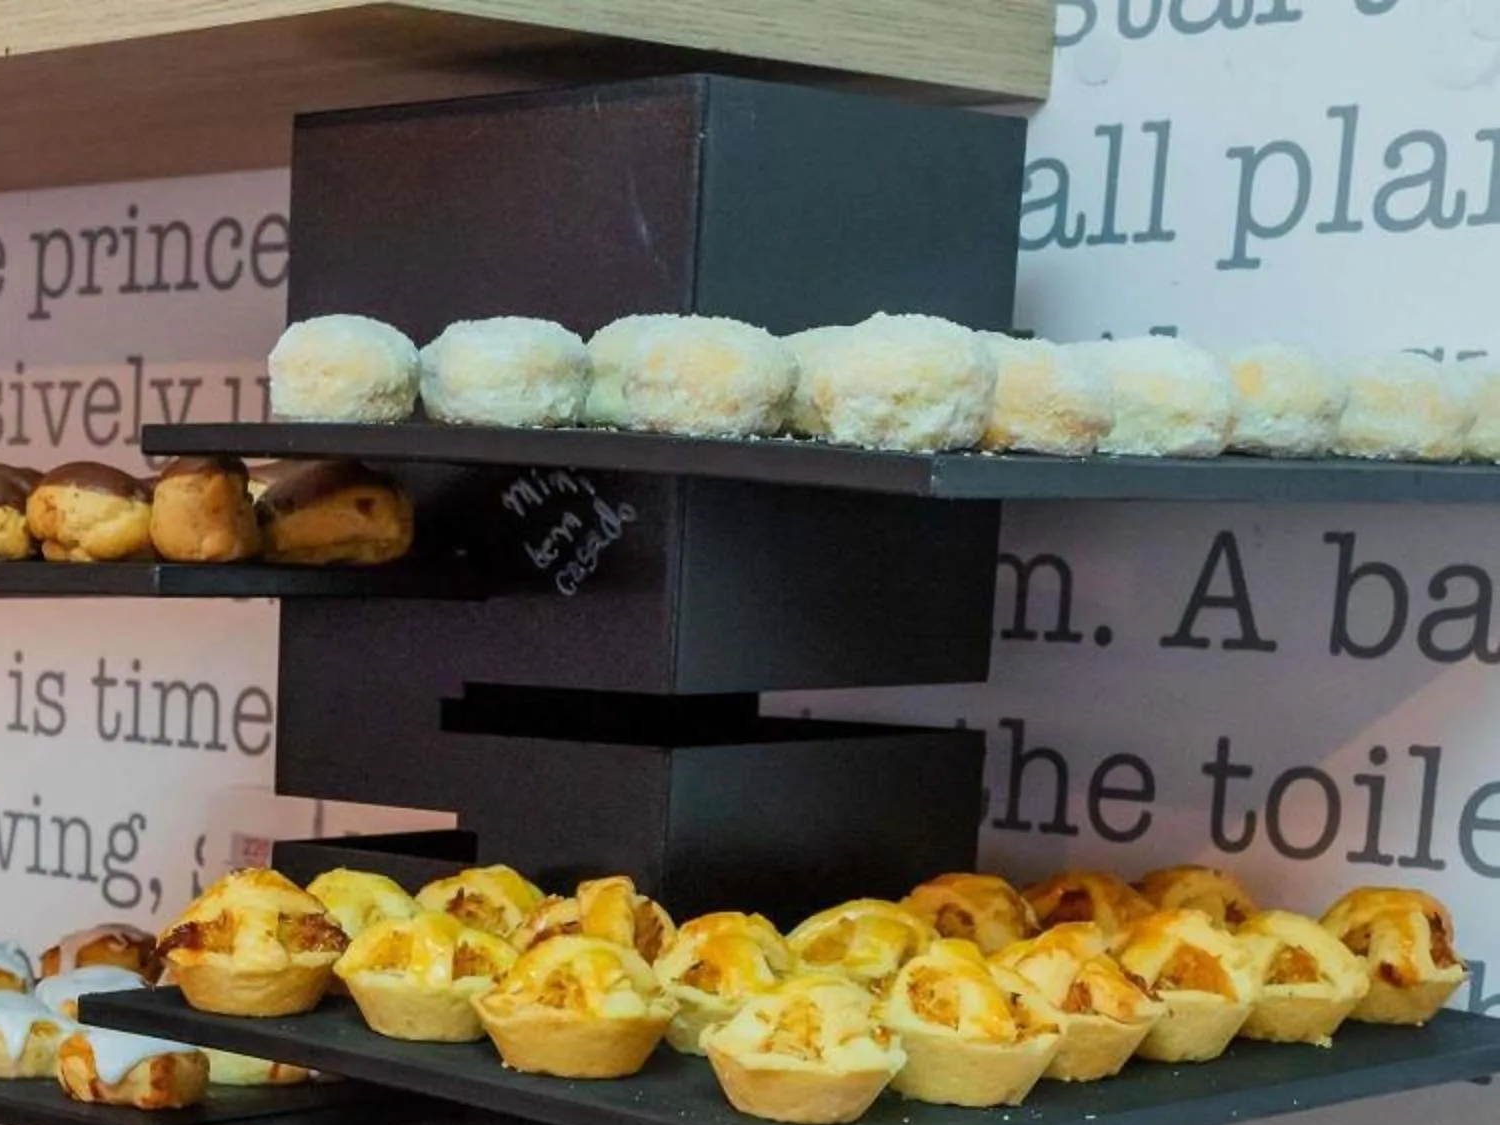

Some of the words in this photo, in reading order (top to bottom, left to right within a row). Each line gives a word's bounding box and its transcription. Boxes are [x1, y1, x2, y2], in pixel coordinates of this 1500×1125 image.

[1018, 119, 1176, 252] all
[28, 205, 291, 320] prince
[1160, 530, 1277, 653] A
[6, 649, 68, 738] is
[91, 654, 276, 757] time
[982, 718, 1156, 844] he
